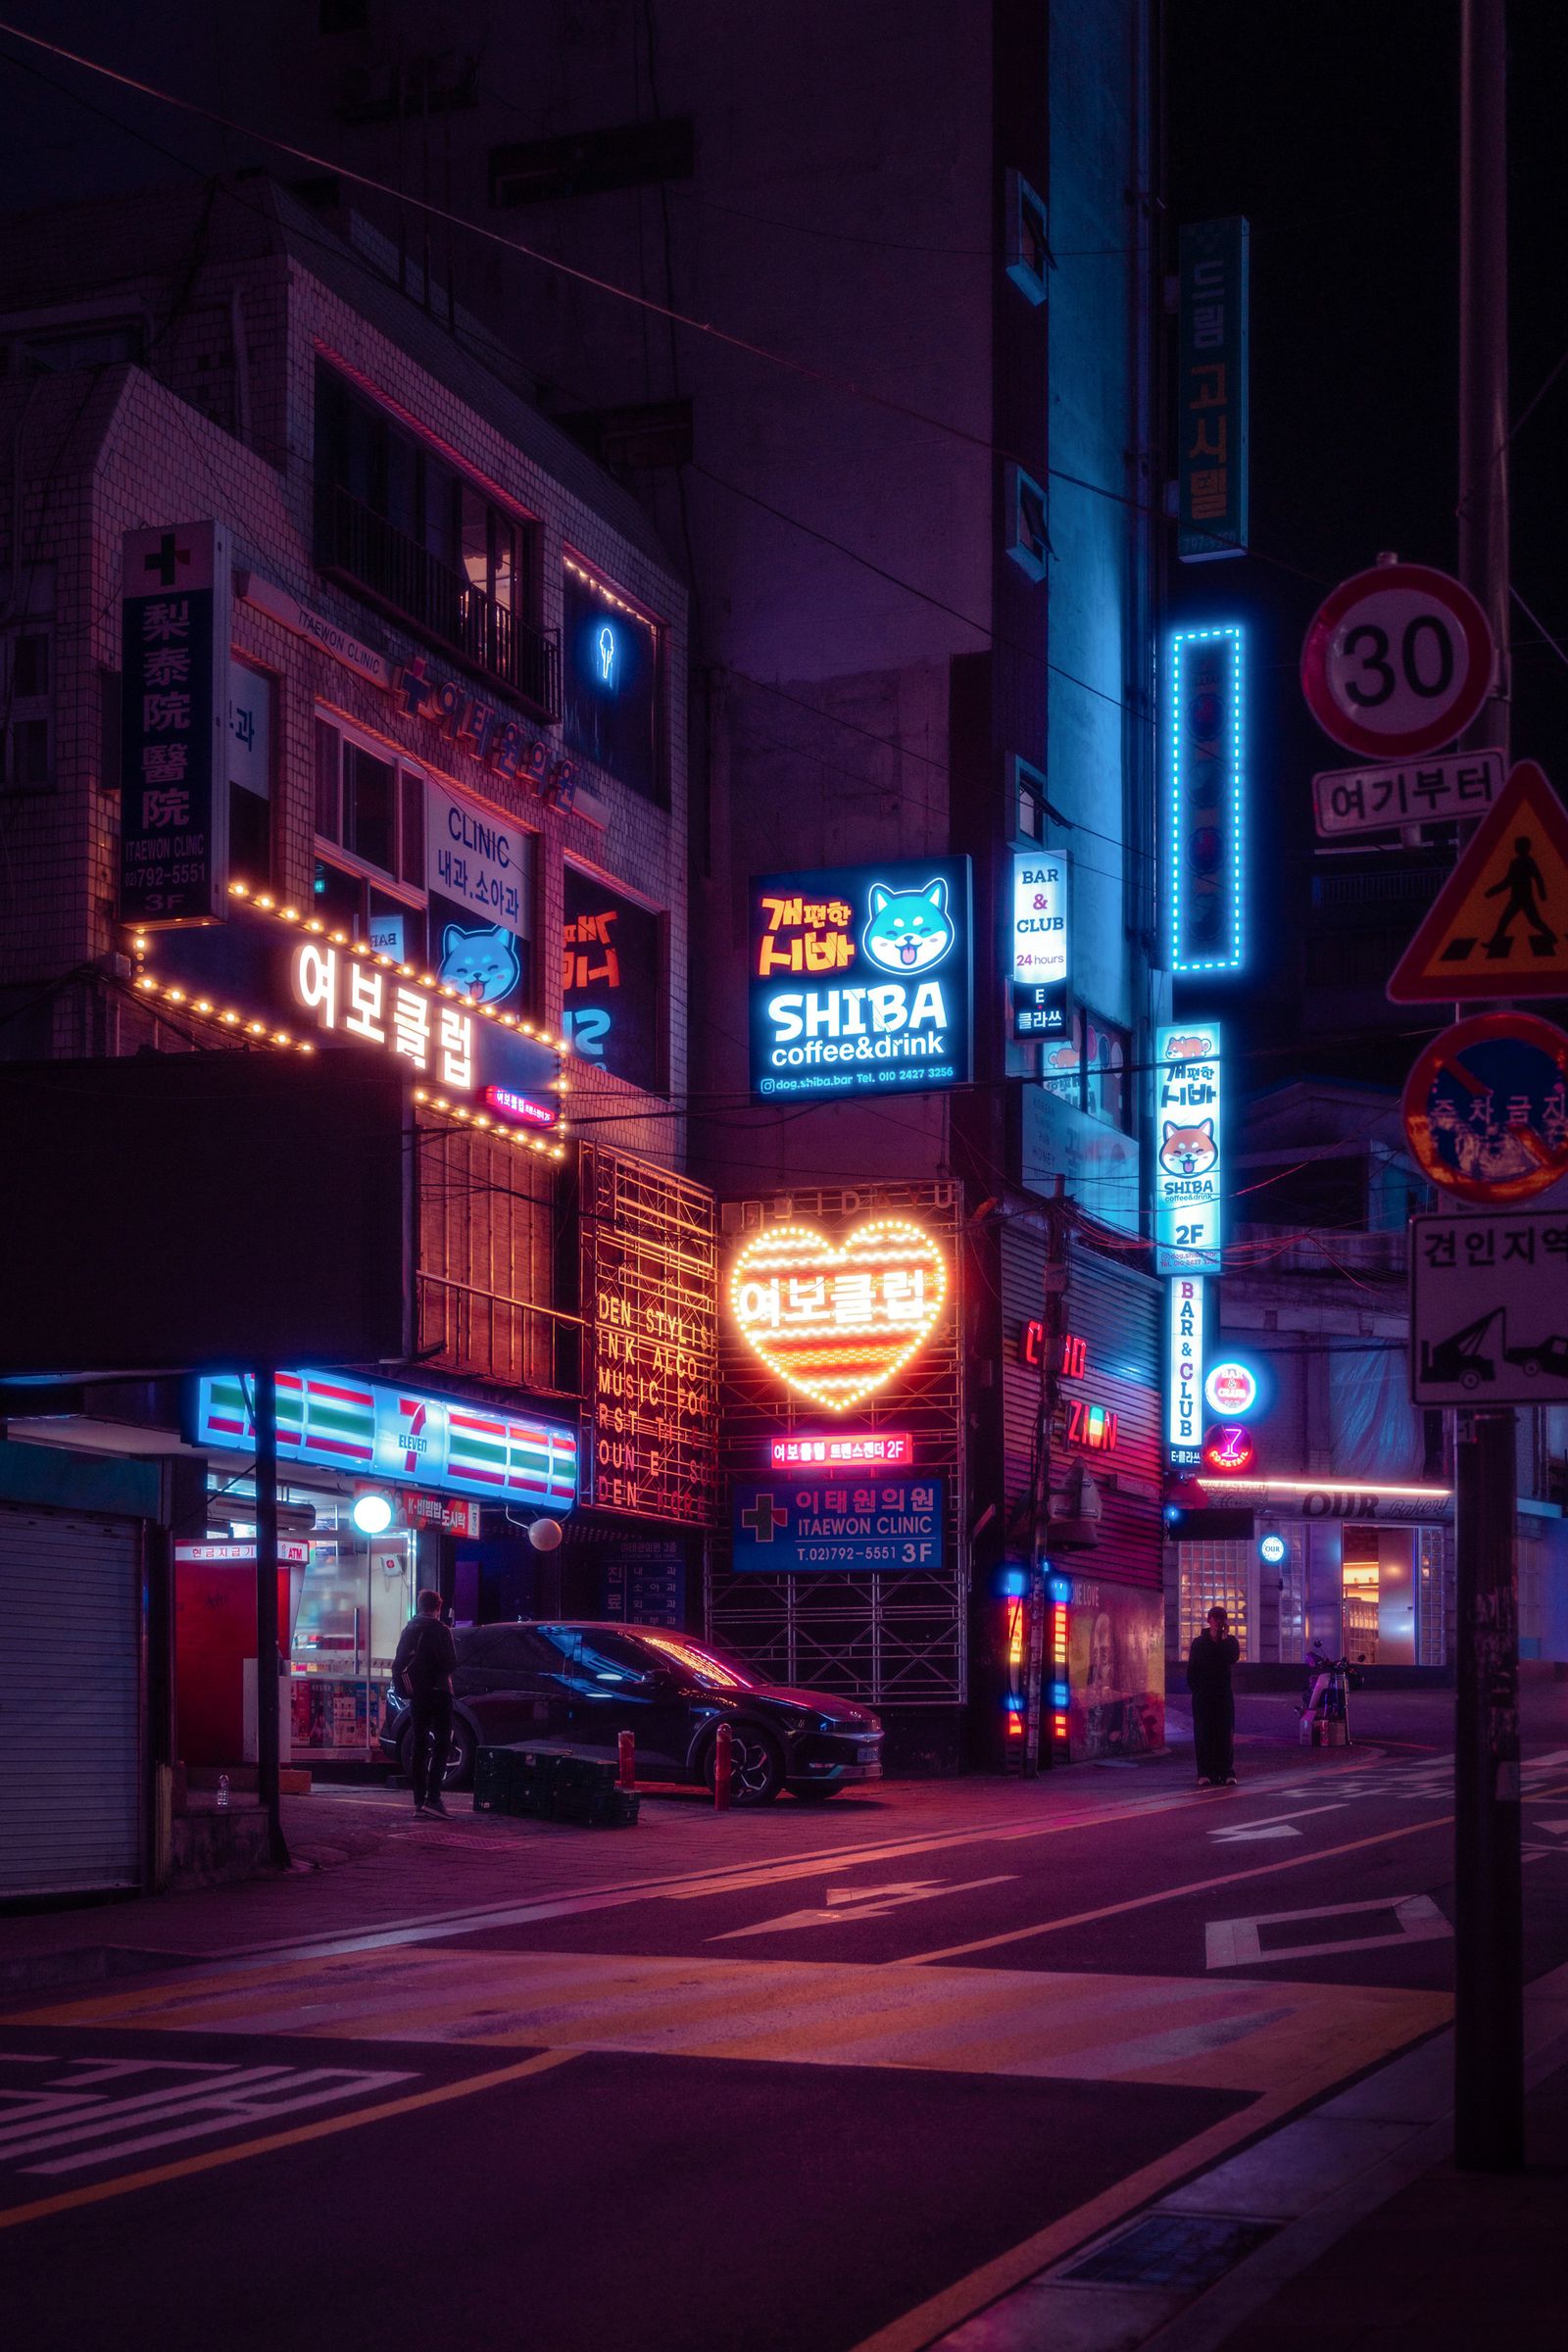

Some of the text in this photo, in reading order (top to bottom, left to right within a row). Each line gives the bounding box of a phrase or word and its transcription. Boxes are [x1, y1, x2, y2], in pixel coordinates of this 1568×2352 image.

[1188, 360, 1228, 530] 고시텔
[297, 610, 381, 676] ITAEWON CLINIC
[1344, 614, 1452, 707] 30
[1331, 762, 1492, 819] 여기부터
[124, 833, 205, 861] ITAEWON CLINIC
[447, 807, 510, 868] CLINIC
[1022, 869, 1059, 884] BAR
[143, 893, 186, 911] 3F
[761, 898, 852, 931] 개편한
[1032, 893, 1049, 910] &
[1016, 917, 1064, 933] CLUB
[759, 931, 856, 975] 시바
[1016, 954, 1064, 966] 24 hours
[1035, 989, 1045, 1004] E
[298, 944, 471, 1090] 여보클럽
[767, 981, 949, 1043] SHIBA
[1018, 1010, 1062, 1029] 클라쓰
[771, 1030, 945, 1067] coffee&drink
[775, 1066, 954, 1091] dog.shiba.bar Tel. 010 2427 3256
[1160, 1083, 1217, 1108] 시바
[1164, 1179, 1214, 1196] SHIBA
[1176, 1224, 1204, 1246] 2F
[599, 1293, 631, 1328] DEN
[738, 1268, 925, 1328] 여보클럽
[1180, 1281, 1195, 1338] BAR
[1181, 1342, 1193, 1357] &
[599, 1365, 659, 1406] MUSIC
[1179, 1362, 1195, 1438] CLUB
[399, 1397, 426, 1473] 7
[1068, 1399, 1118, 1450] ZION
[774, 1442, 825, 1461] 여보클럽
[887, 1440, 905, 1458] 2F
[1209, 1450, 1249, 1468] COCKTAIL
[598, 1475, 637, 1507] DEN
[796, 1488, 934, 1514] 이태원의원
[1301, 1491, 1380, 1518] OUR
[1384, 1496, 1451, 1518] Bakery
[798, 1515, 933, 1537] ITAEWON CLINIC
[287, 1547, 303, 1560] ATM
[797, 1543, 933, 1563] T.02)792-5551 3F
[1264, 1544, 1281, 1553] OUR
